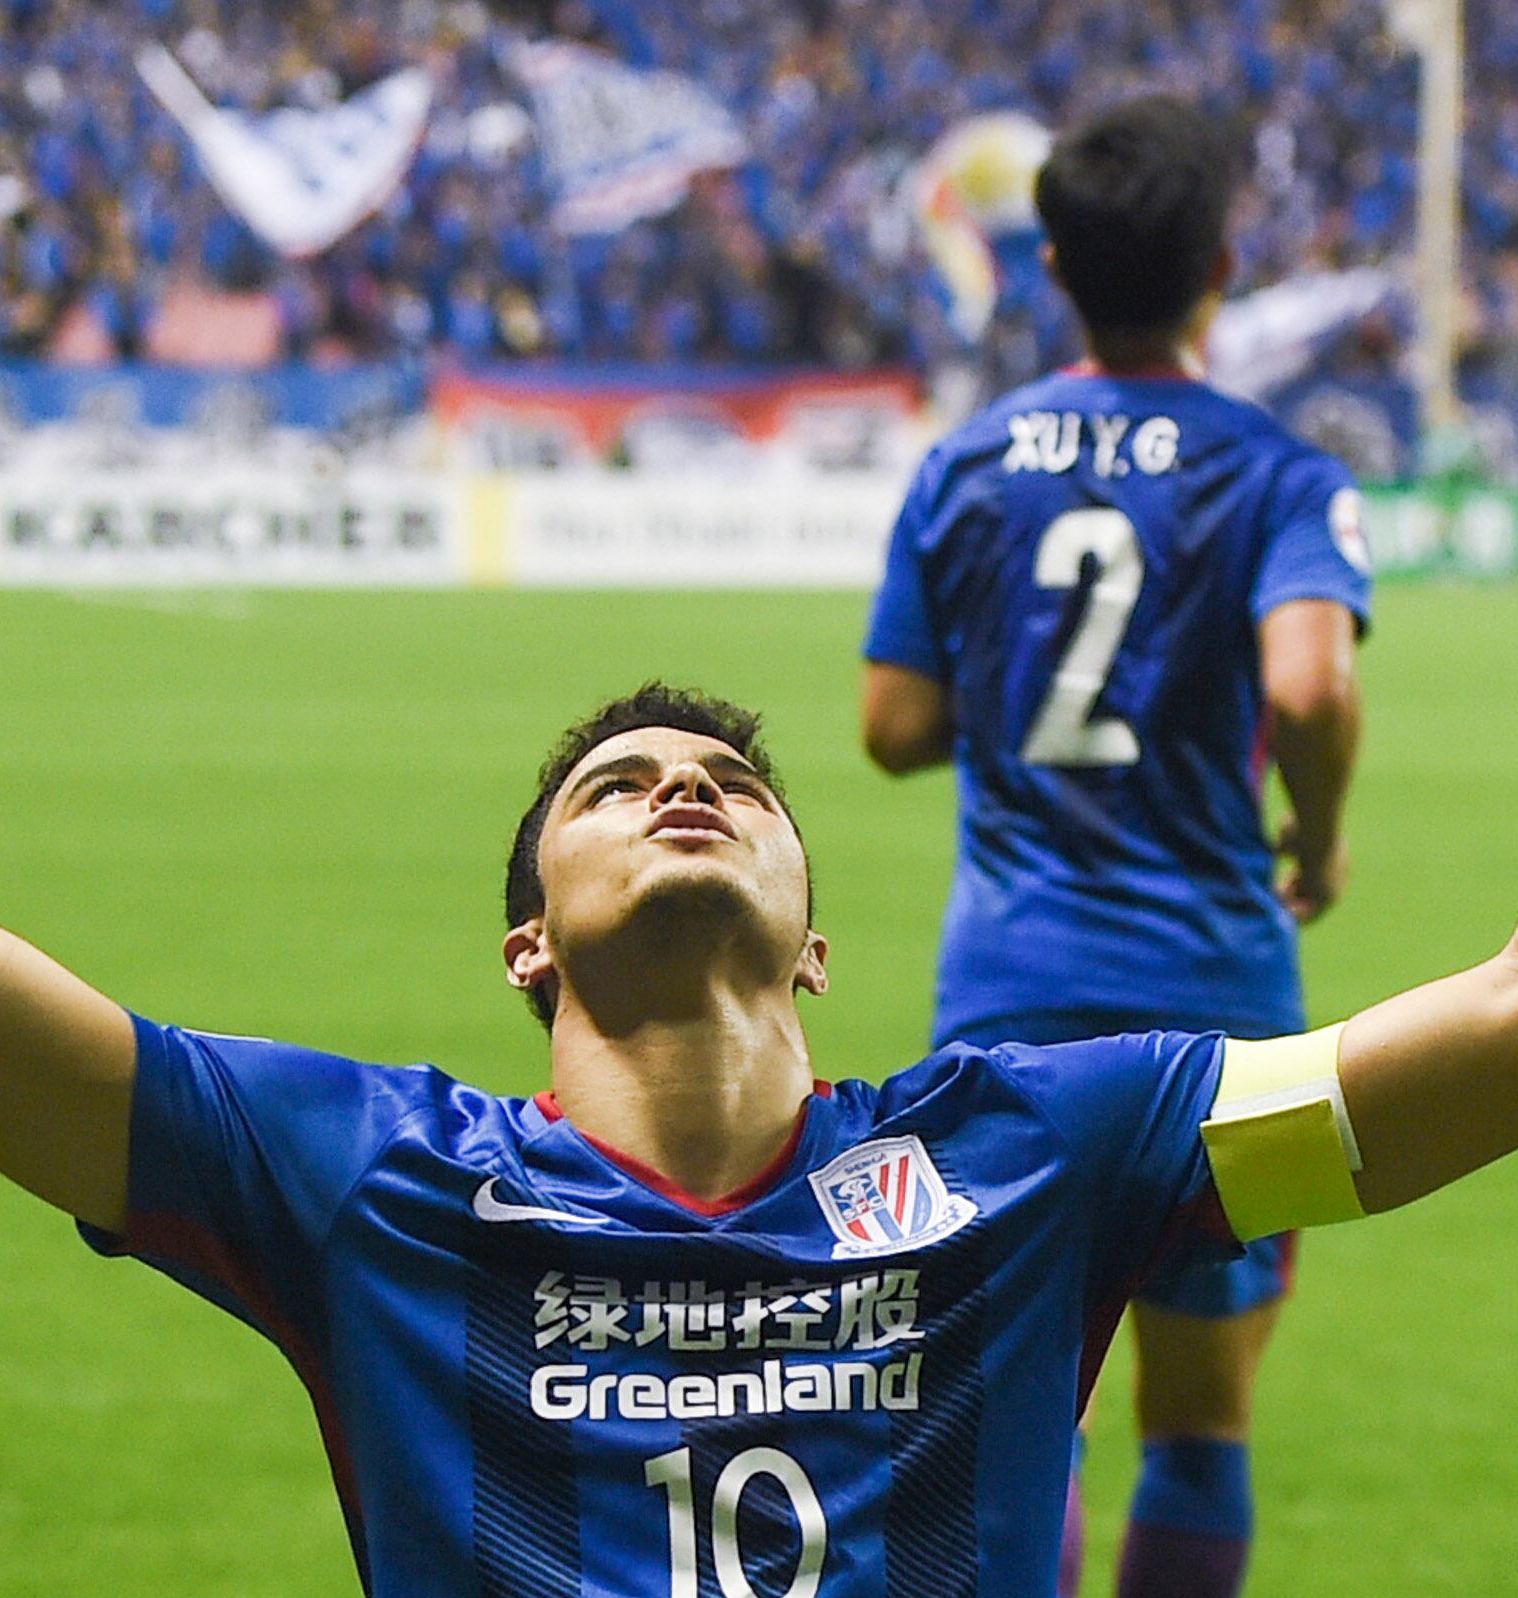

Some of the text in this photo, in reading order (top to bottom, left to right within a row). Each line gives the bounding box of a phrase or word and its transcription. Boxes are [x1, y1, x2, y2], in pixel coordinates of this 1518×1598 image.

[1001, 411, 1081, 475] XU
[1021, 507, 1145, 768] 2
[840, 1196, 885, 1222] SFC
[533, 1268, 926, 1351] 绿地控股
[529, 1354, 922, 1420] Greenland
